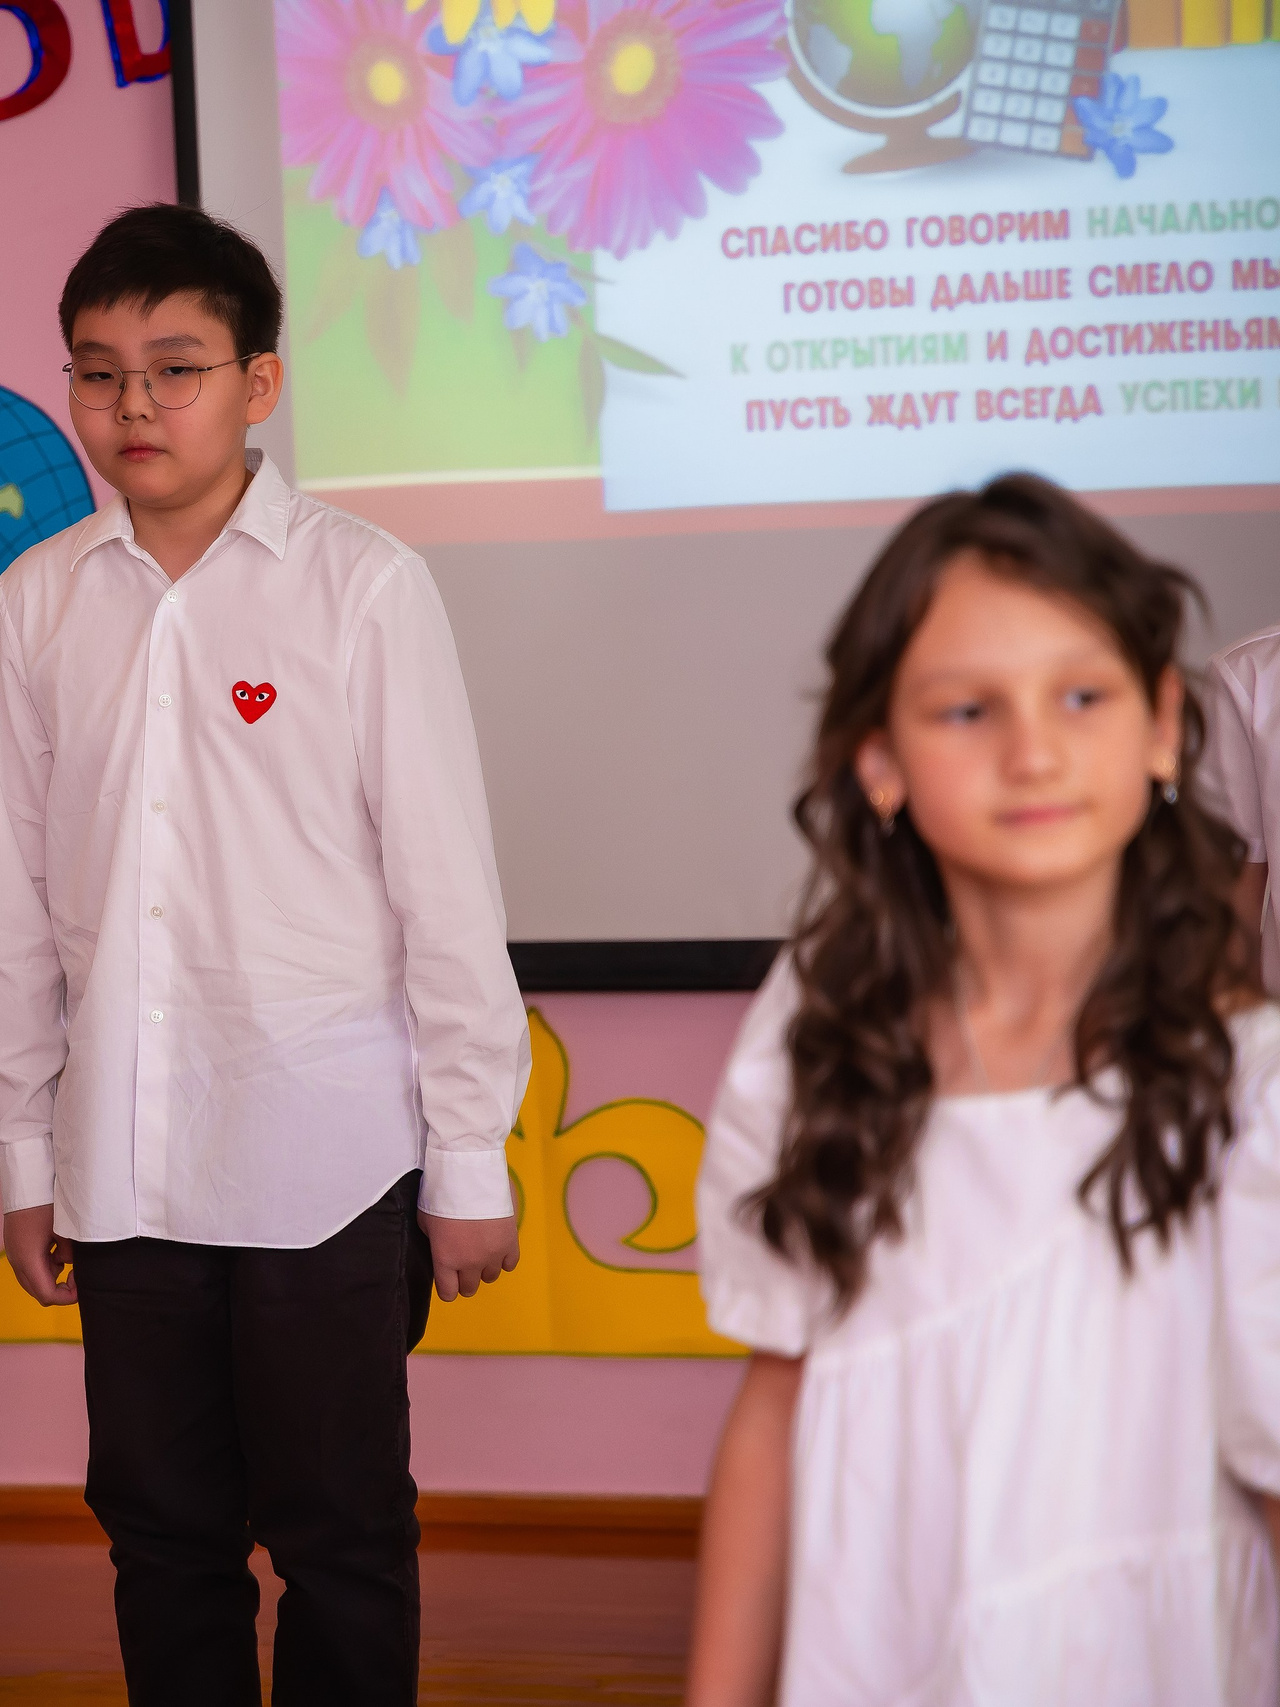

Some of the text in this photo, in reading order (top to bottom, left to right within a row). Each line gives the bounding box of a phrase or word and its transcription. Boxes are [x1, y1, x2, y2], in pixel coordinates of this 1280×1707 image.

[721, 219, 889, 259] СПАСИБО
[906, 208, 1071, 247] ГОВОРИМ
[783, 276, 915, 313] ГОТОВЫ
[931, 267, 1072, 311] ДАЛЬШЕ
[1089, 260, 1214, 297] СМЕЛО
[730, 344, 749, 374] К
[767, 331, 970, 372] ОТКРЫТИЯМ
[987, 330, 1008, 361] И
[746, 397, 851, 431] ПУСТЬ
[867, 391, 959, 430] ЖДУТ
[976, 384, 1104, 423] ВСЕГДА
[1121, 377, 1264, 412] УСПЕХИ
